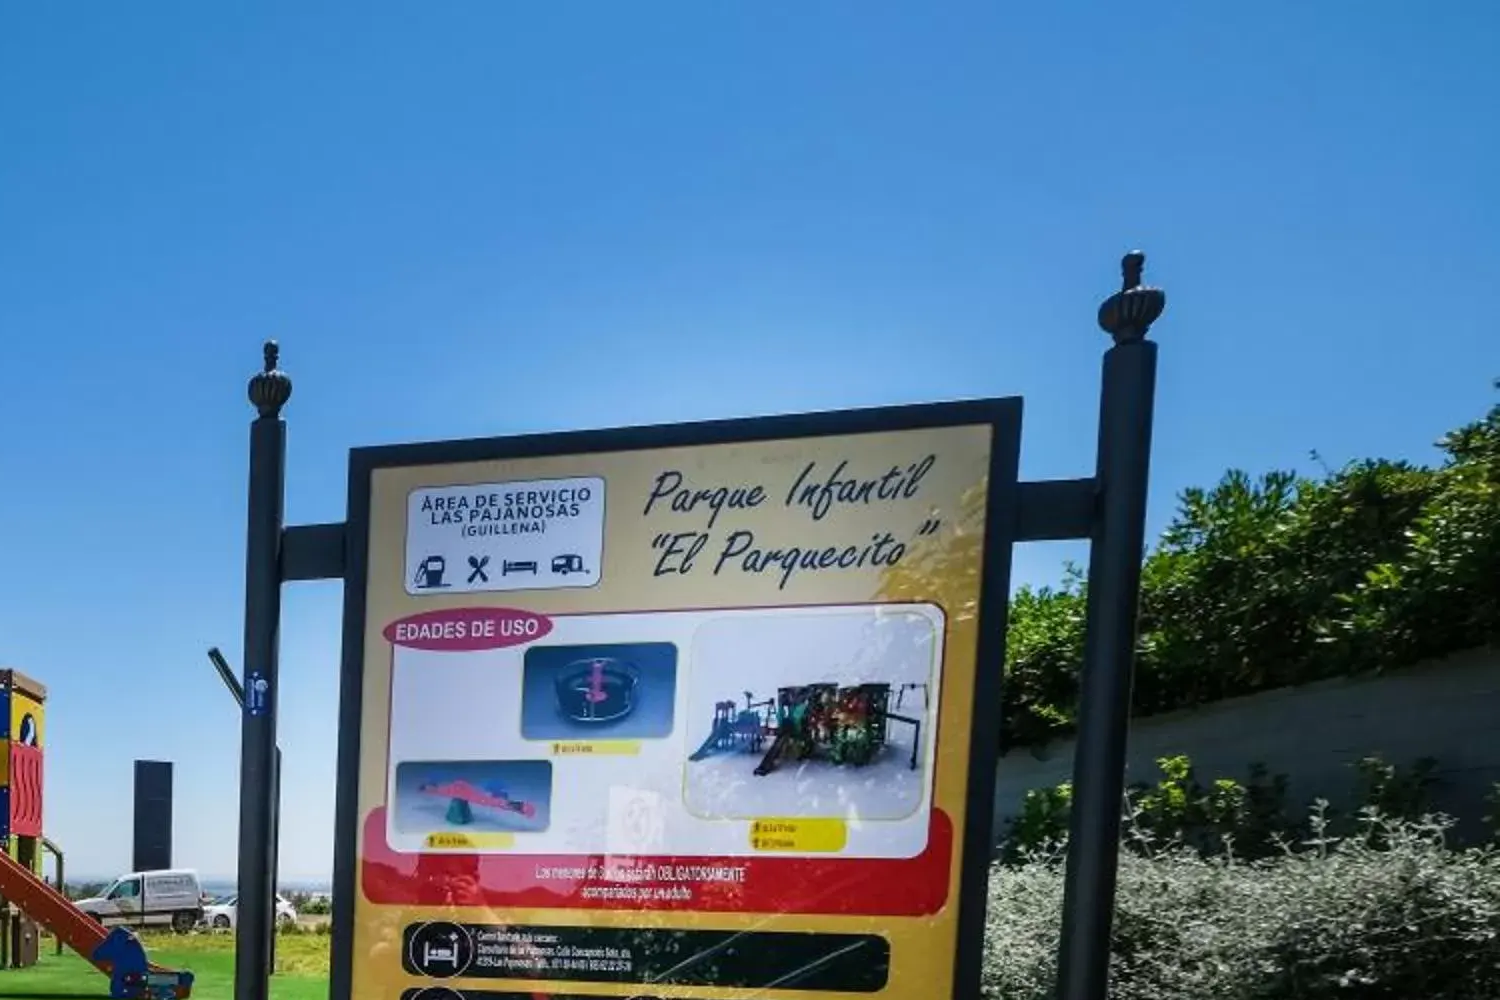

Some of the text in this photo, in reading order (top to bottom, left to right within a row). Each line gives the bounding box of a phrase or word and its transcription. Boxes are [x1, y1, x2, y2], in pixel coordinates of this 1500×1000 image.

[421, 488, 591, 512] ÁREA DE SERVICIO
[643, 455, 936, 528] Parque Infantil
[431, 503, 580, 525] LAS PAJANOSAS
[461, 520, 546, 538] (GUILLENA)
[395, 619, 539, 641] EDADES DE USO
